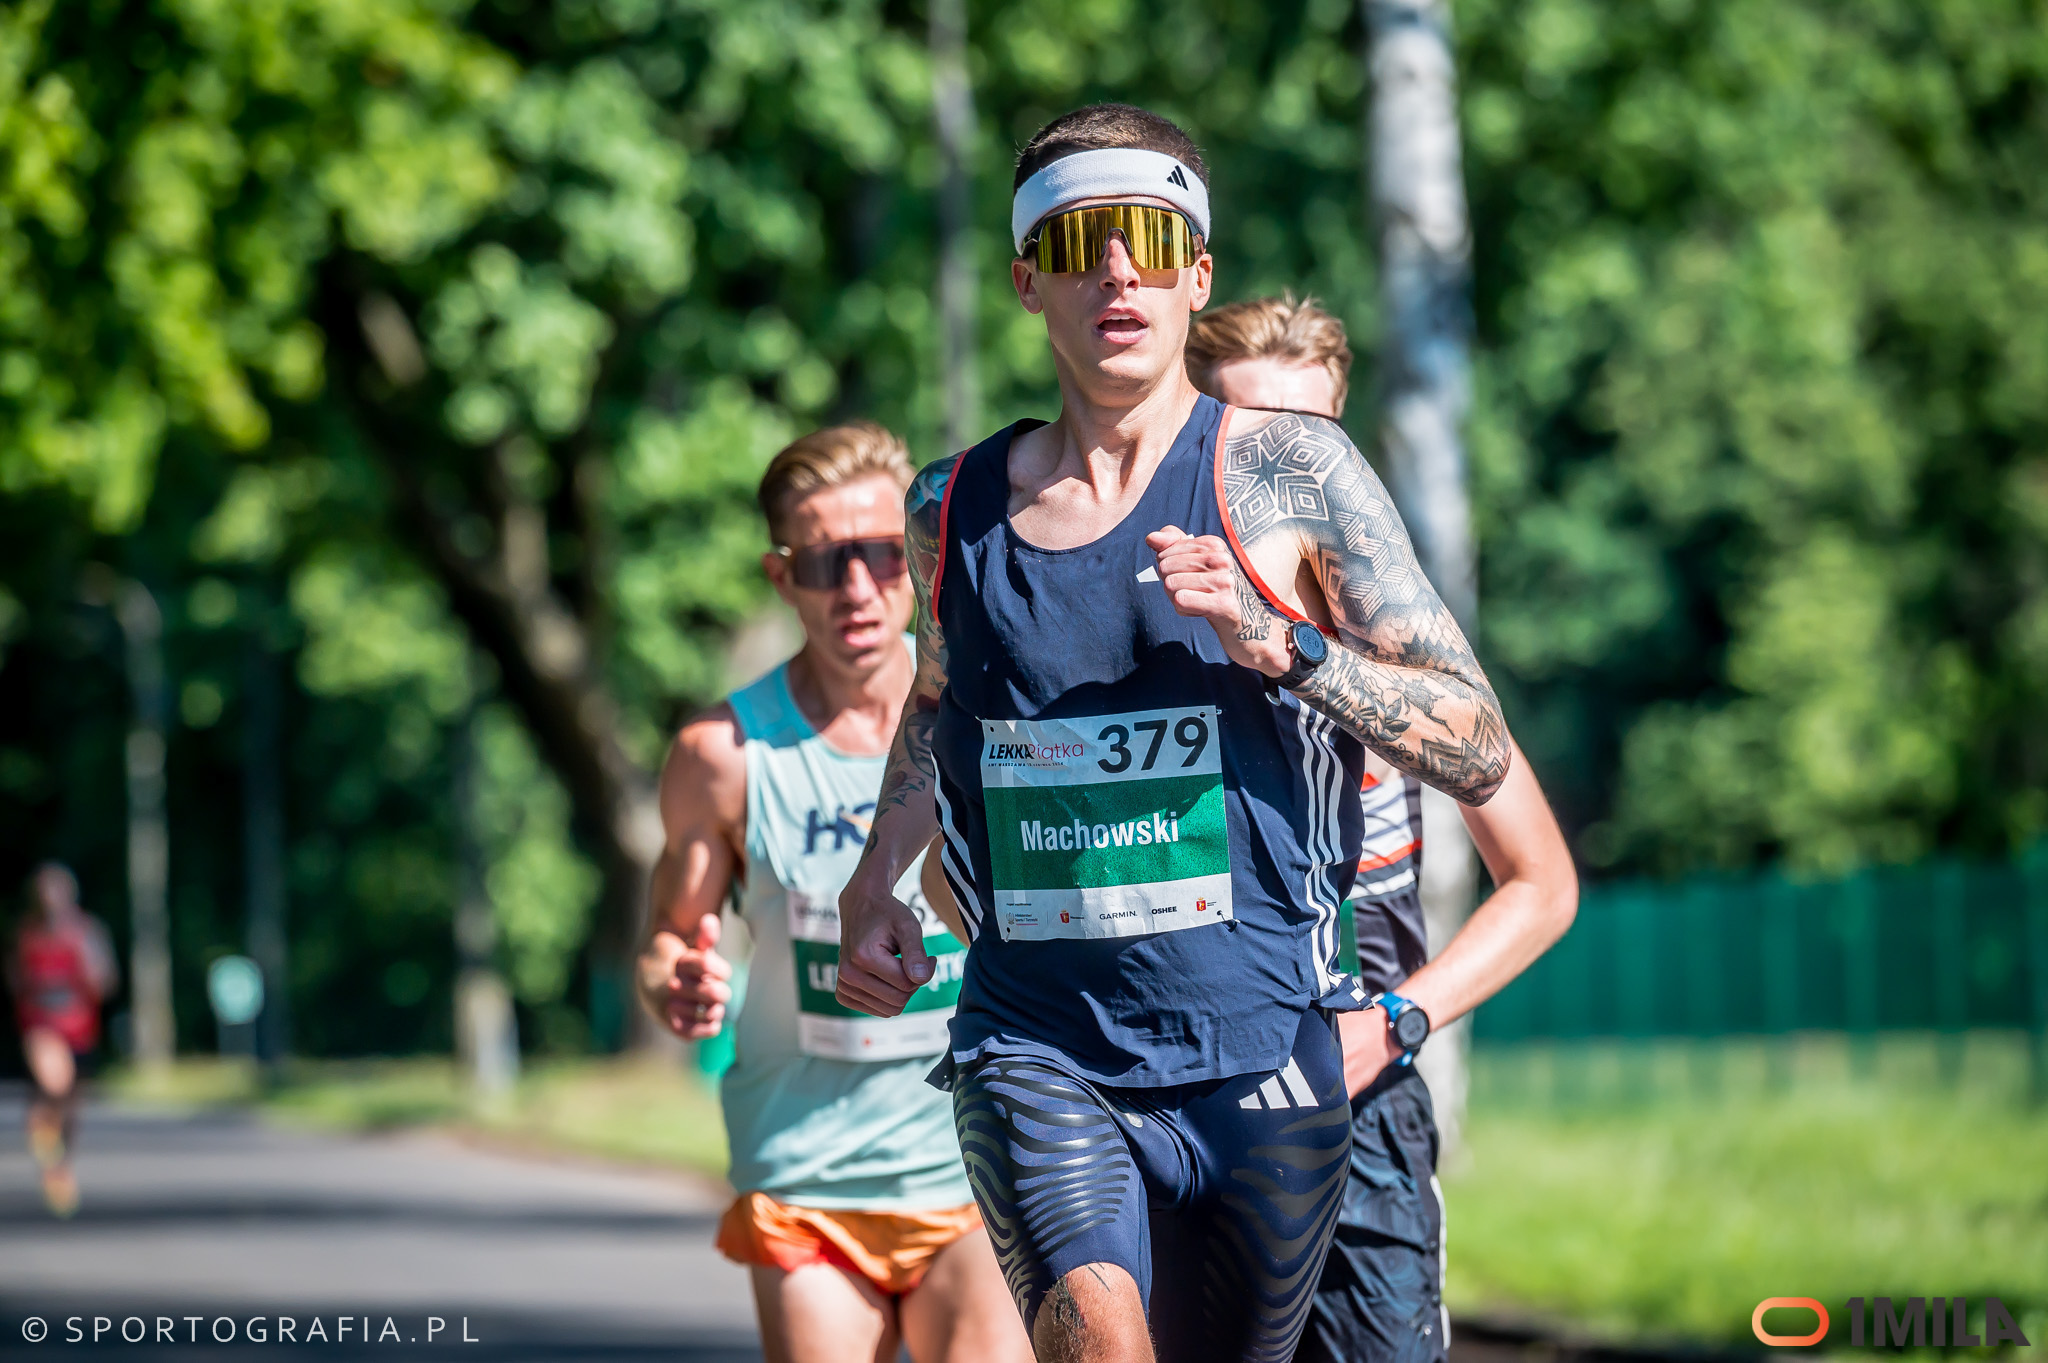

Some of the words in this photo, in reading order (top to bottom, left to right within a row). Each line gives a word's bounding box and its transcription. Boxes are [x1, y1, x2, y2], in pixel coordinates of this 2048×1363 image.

[1097, 716, 1209, 774] 379
[1020, 811, 1179, 851] Machowski
[1099, 910, 1136, 920] GARMIN
[1151, 906, 1178, 915] OSHEE
